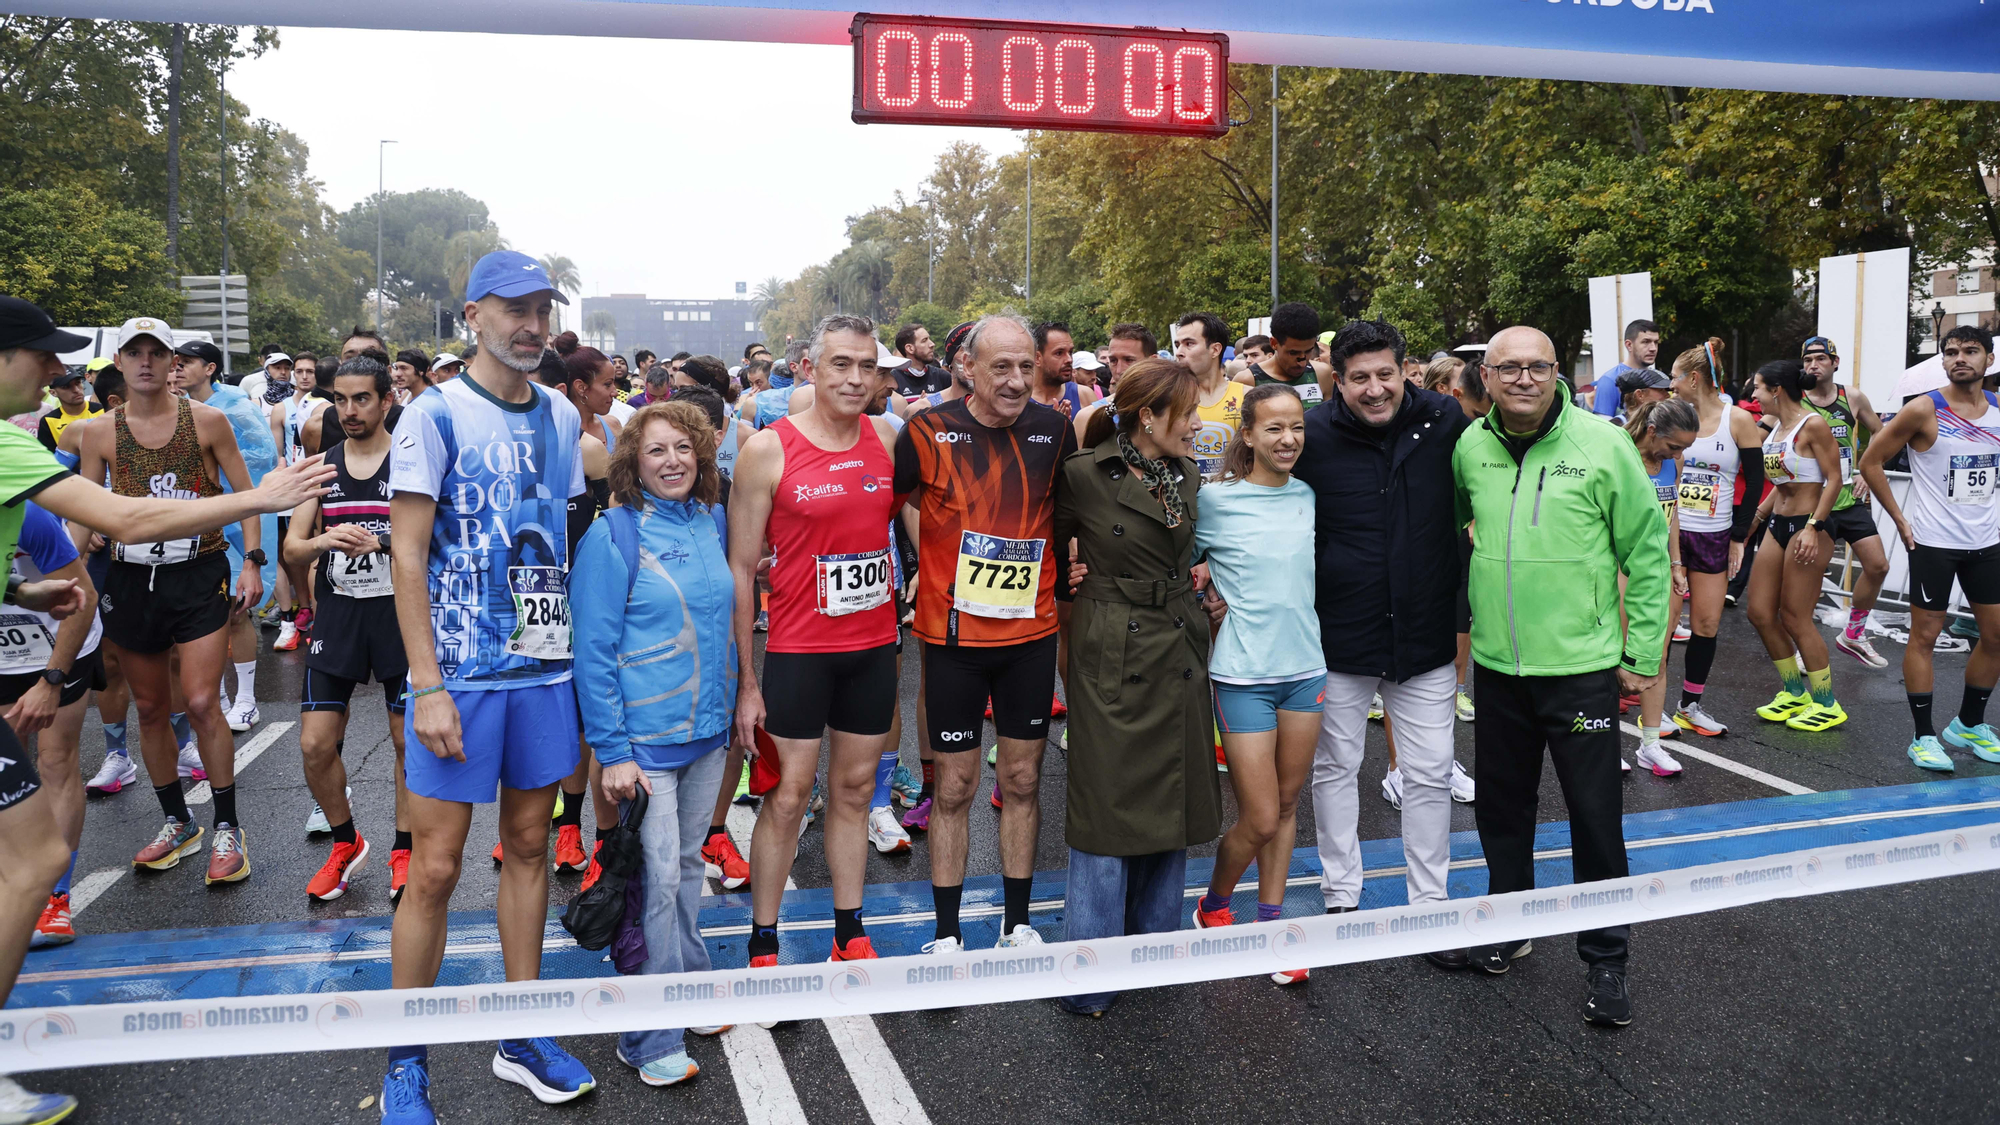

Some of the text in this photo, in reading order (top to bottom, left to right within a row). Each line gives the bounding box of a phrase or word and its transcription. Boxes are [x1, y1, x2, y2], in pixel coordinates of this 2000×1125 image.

[1027, 435, 1052, 444] 42K
[1764, 456, 1780, 469] 638
[1967, 470, 1987, 487] 56
[806, 483, 844, 497] califas
[1680, 486, 1711, 501] 632
[150, 541, 165, 557] 4
[345, 552, 373, 575] 24
[830, 559, 886, 590] 1300
[968, 560, 1031, 590] 7723
[840, 594, 864, 603] ANTONIO
[865, 590, 881, 600] MIGUEL
[524, 598, 568, 626] 2848
